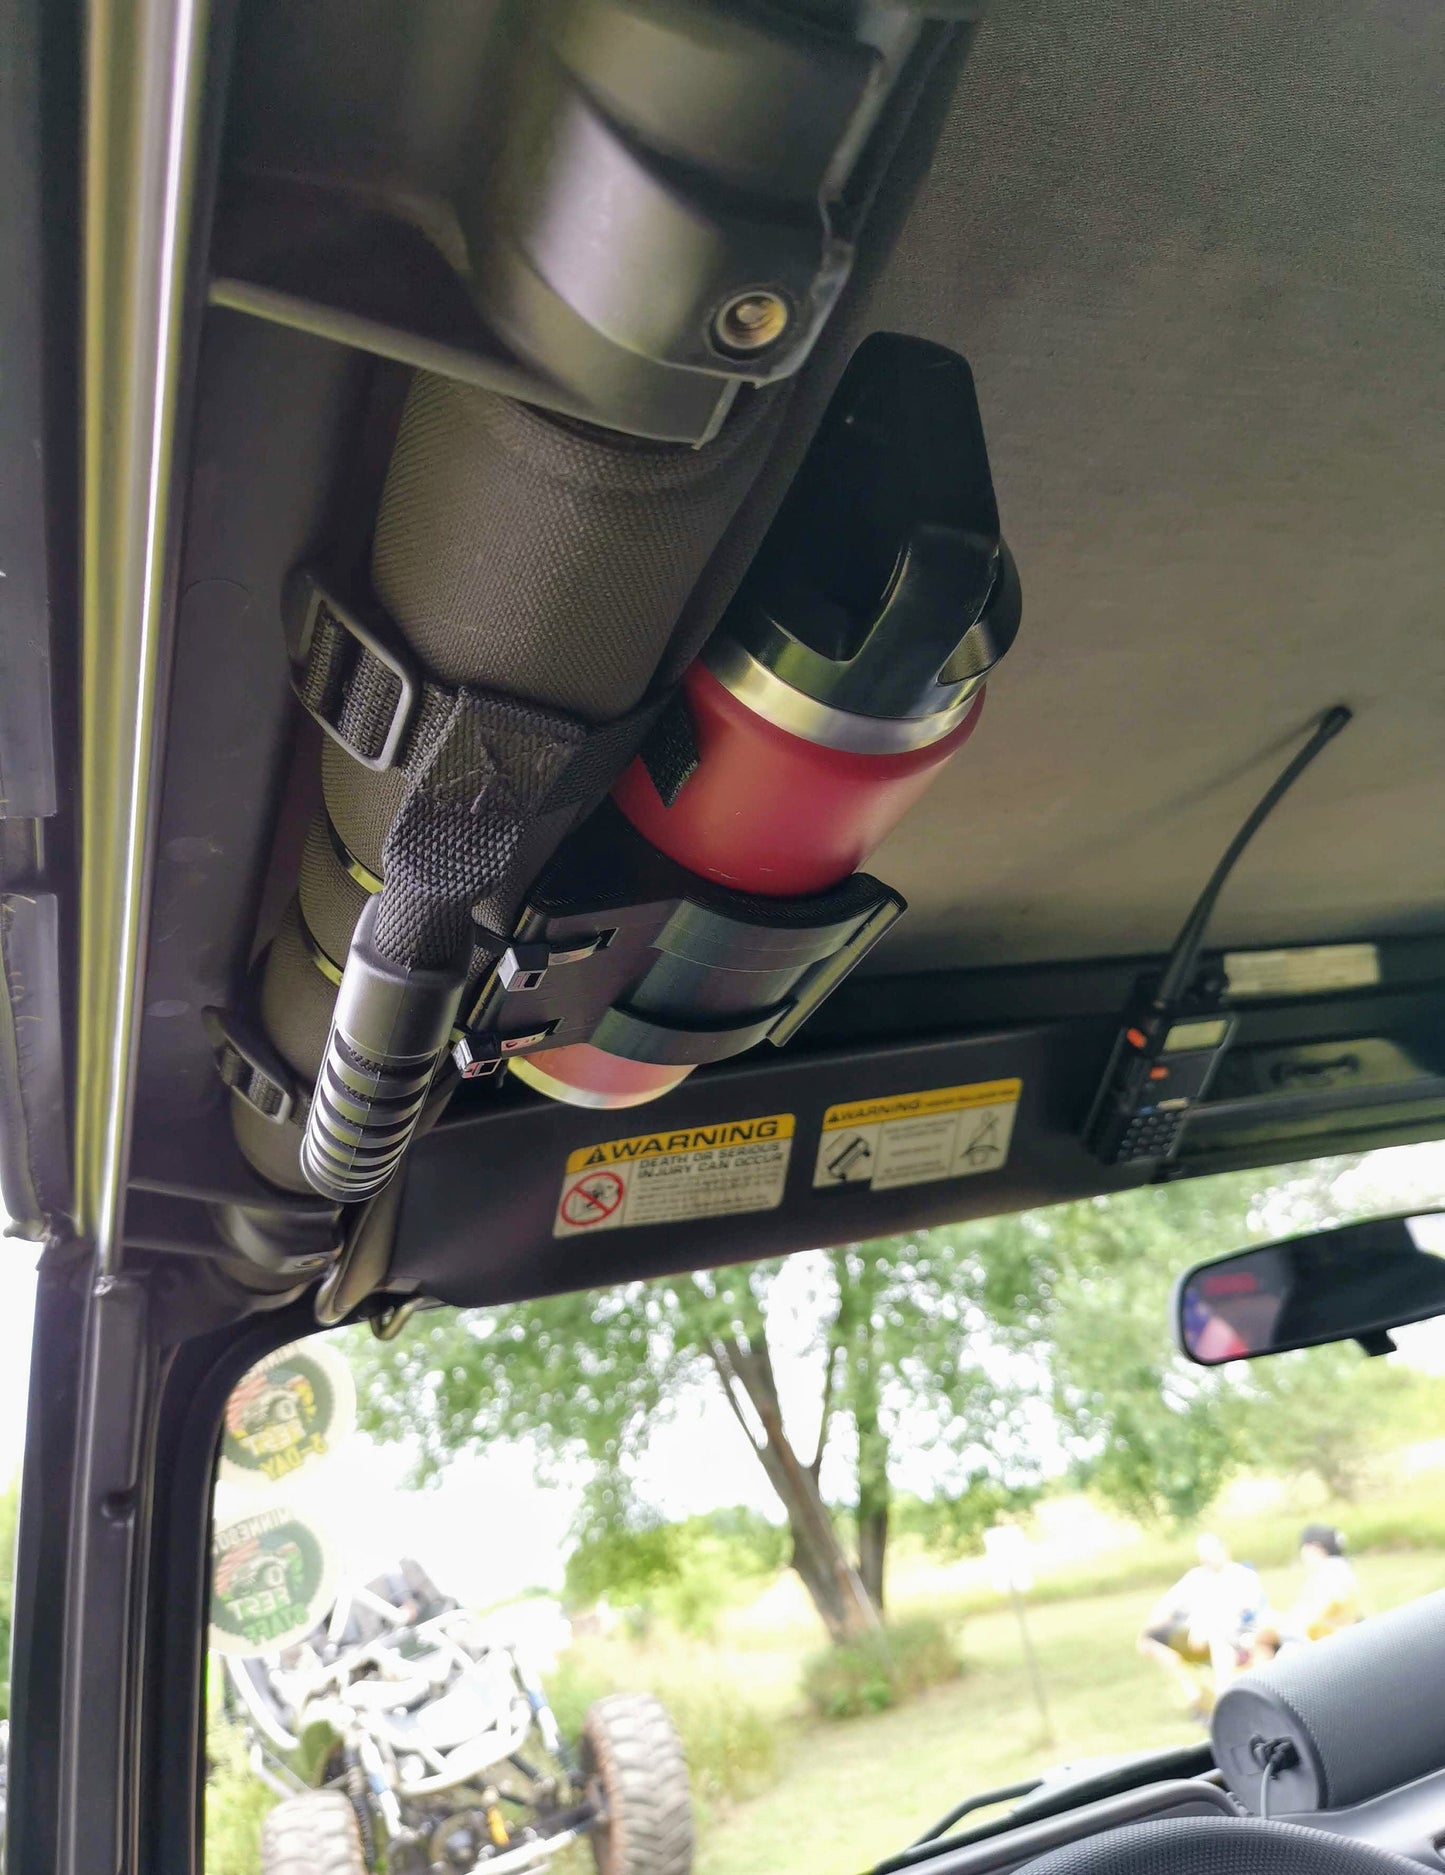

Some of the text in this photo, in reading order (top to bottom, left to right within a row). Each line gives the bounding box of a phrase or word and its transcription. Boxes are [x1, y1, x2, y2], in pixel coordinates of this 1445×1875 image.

[841, 1100, 920, 1121] WARNING
[611, 1119, 779, 1159] WARNING
[638, 1152, 783, 1178] INJURY CAN OCCUR
[639, 1142, 779, 1169] DEATH OR SERIOUS
